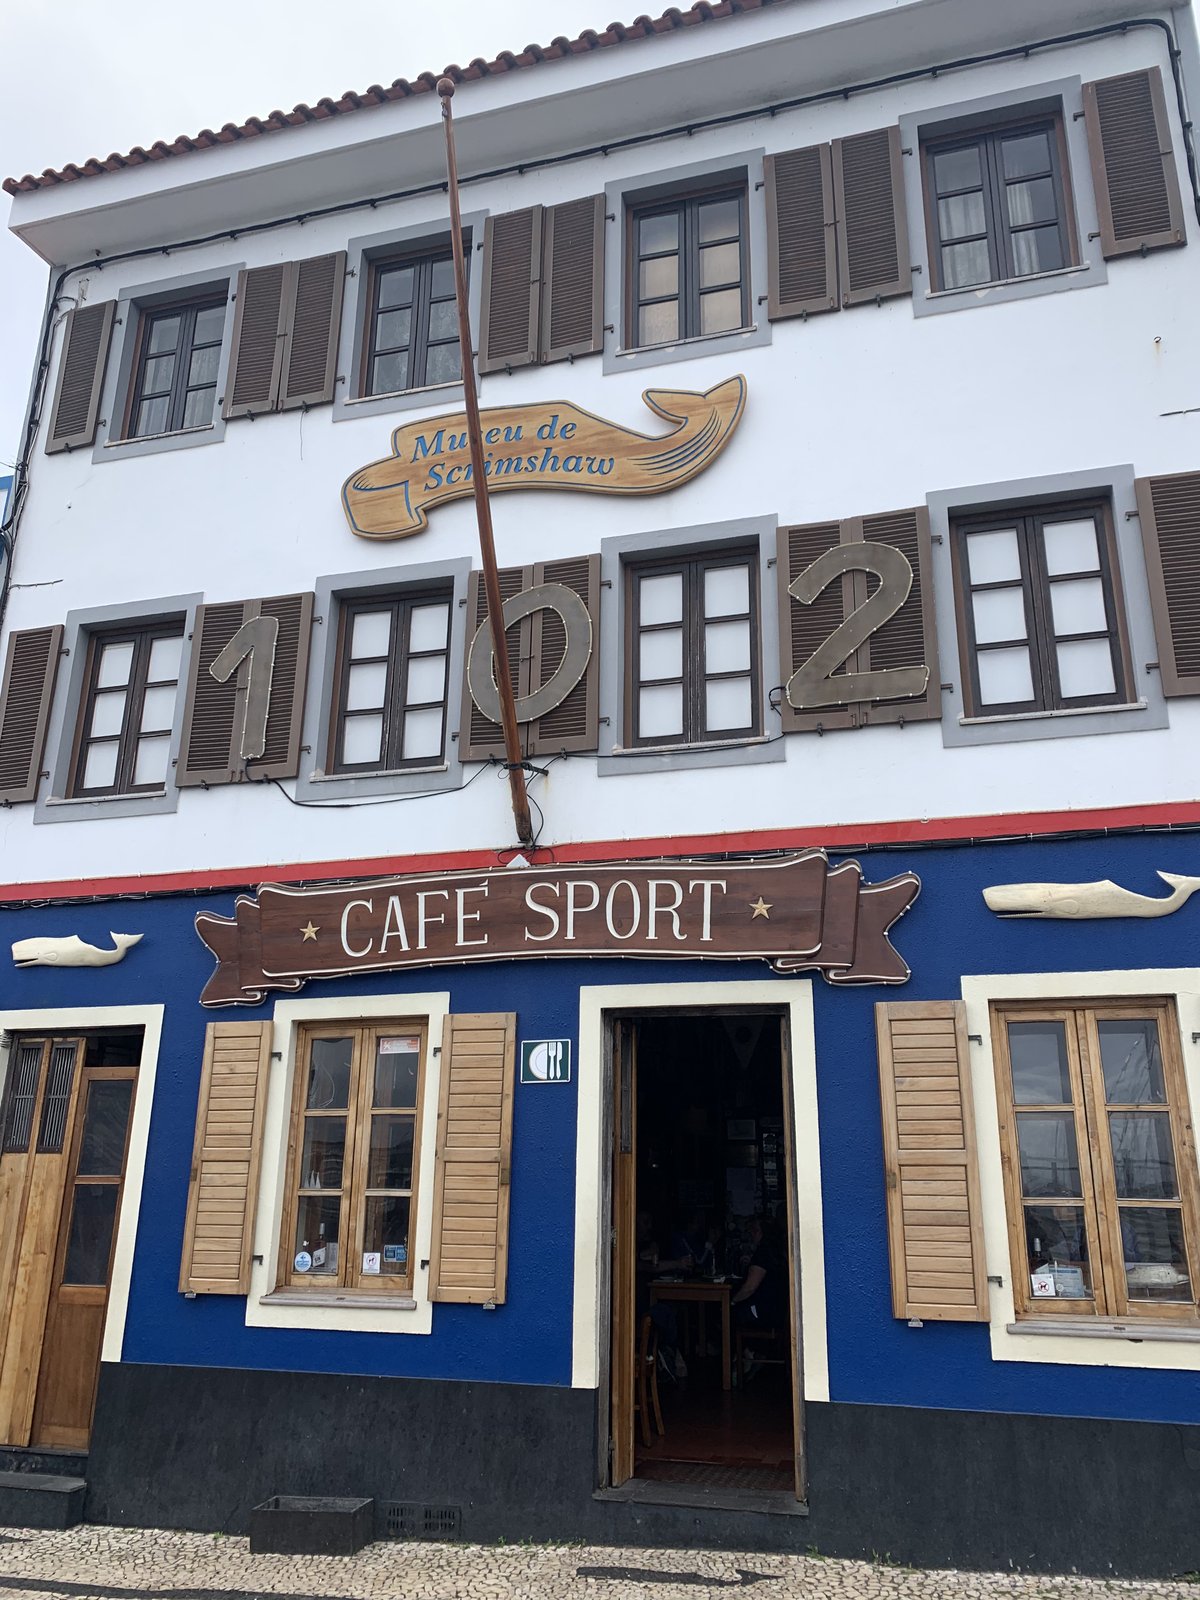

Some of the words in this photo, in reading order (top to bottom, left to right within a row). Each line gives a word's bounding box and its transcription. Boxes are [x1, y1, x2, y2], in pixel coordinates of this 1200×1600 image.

[410, 424, 524, 464] Mueu
[536, 414, 578, 441] de
[339, 879, 489, 958] CAFÉ
[523, 878, 728, 942] SPORT
